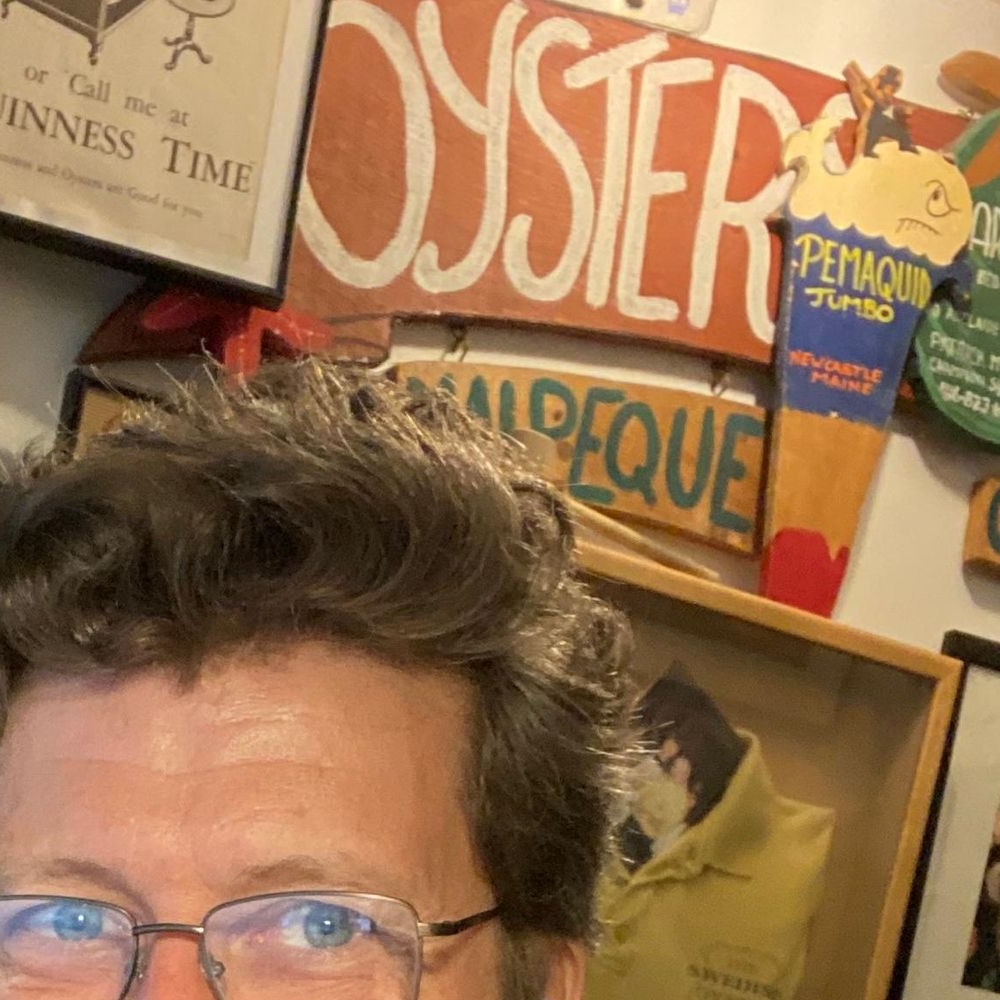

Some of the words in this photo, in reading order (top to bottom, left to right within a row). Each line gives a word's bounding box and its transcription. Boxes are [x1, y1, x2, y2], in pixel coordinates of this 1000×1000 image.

[24, 63, 49, 85] or
[66, 72, 111, 104] Call
[124, 94, 157, 118] me
[169, 107, 190, 128] at
[161, 136, 254, 194] TIME
[793, 232, 933, 310] PEMAQUID
[804, 287, 896, 324] JUMBO
[789, 350, 884, 384] NEWCASTLE
[810, 371, 875, 396] MAINE
[405, 371, 766, 534] PEQUE
